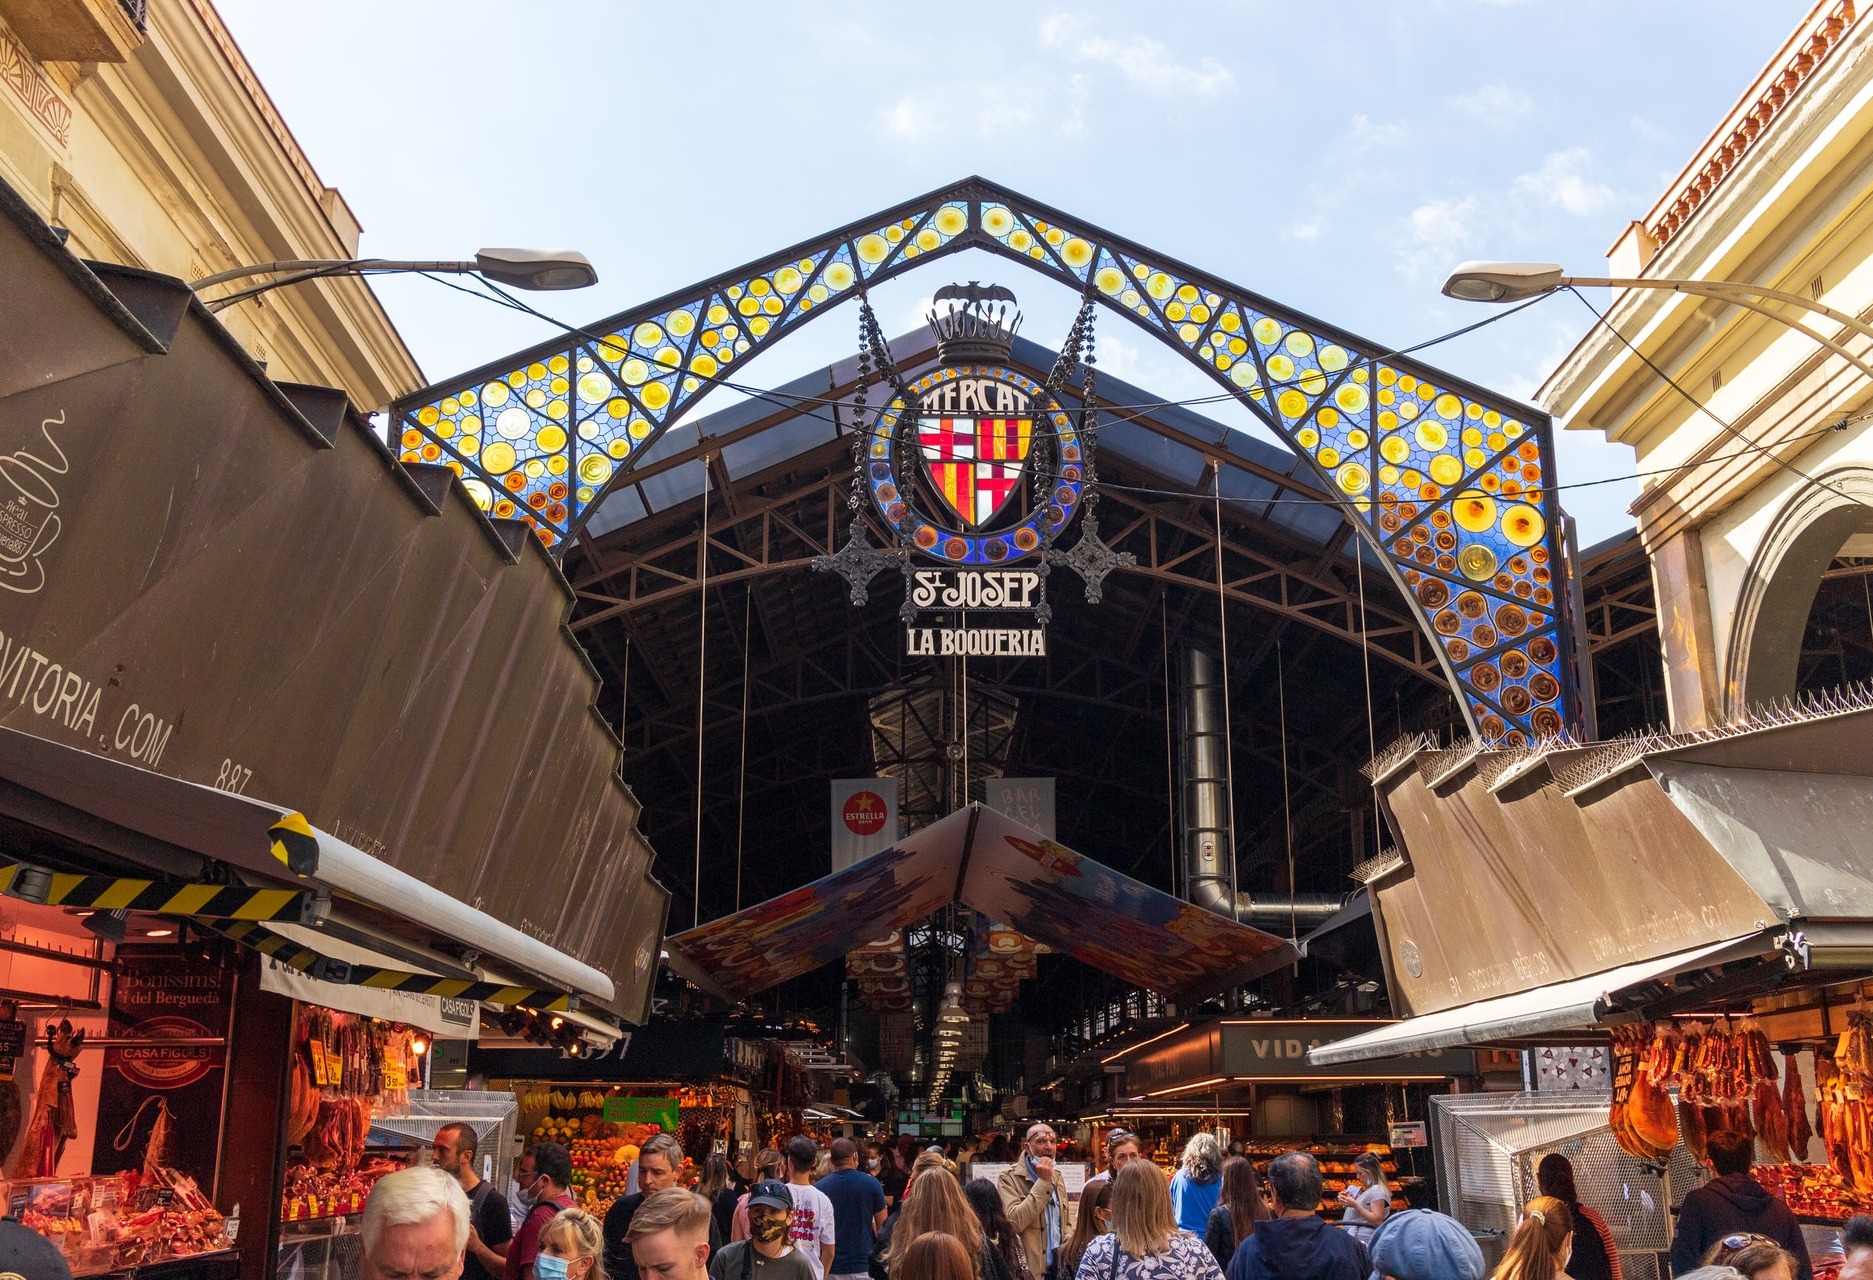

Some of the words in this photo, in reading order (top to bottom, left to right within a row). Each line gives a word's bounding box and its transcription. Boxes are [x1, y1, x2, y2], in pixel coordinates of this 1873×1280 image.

[921, 378, 1029, 415] MERCAT
[942, 571, 1039, 607] JOSEP
[908, 629, 934, 655] LA
[941, 629, 1045, 655] BOQUERIA
[214, 758, 252, 794] 887
[846, 812, 885, 821] ESTRELLA
[131, 990, 151, 1004] del
[155, 990, 220, 1008] Berguedà
[123, 1047, 158, 1058] CASA
